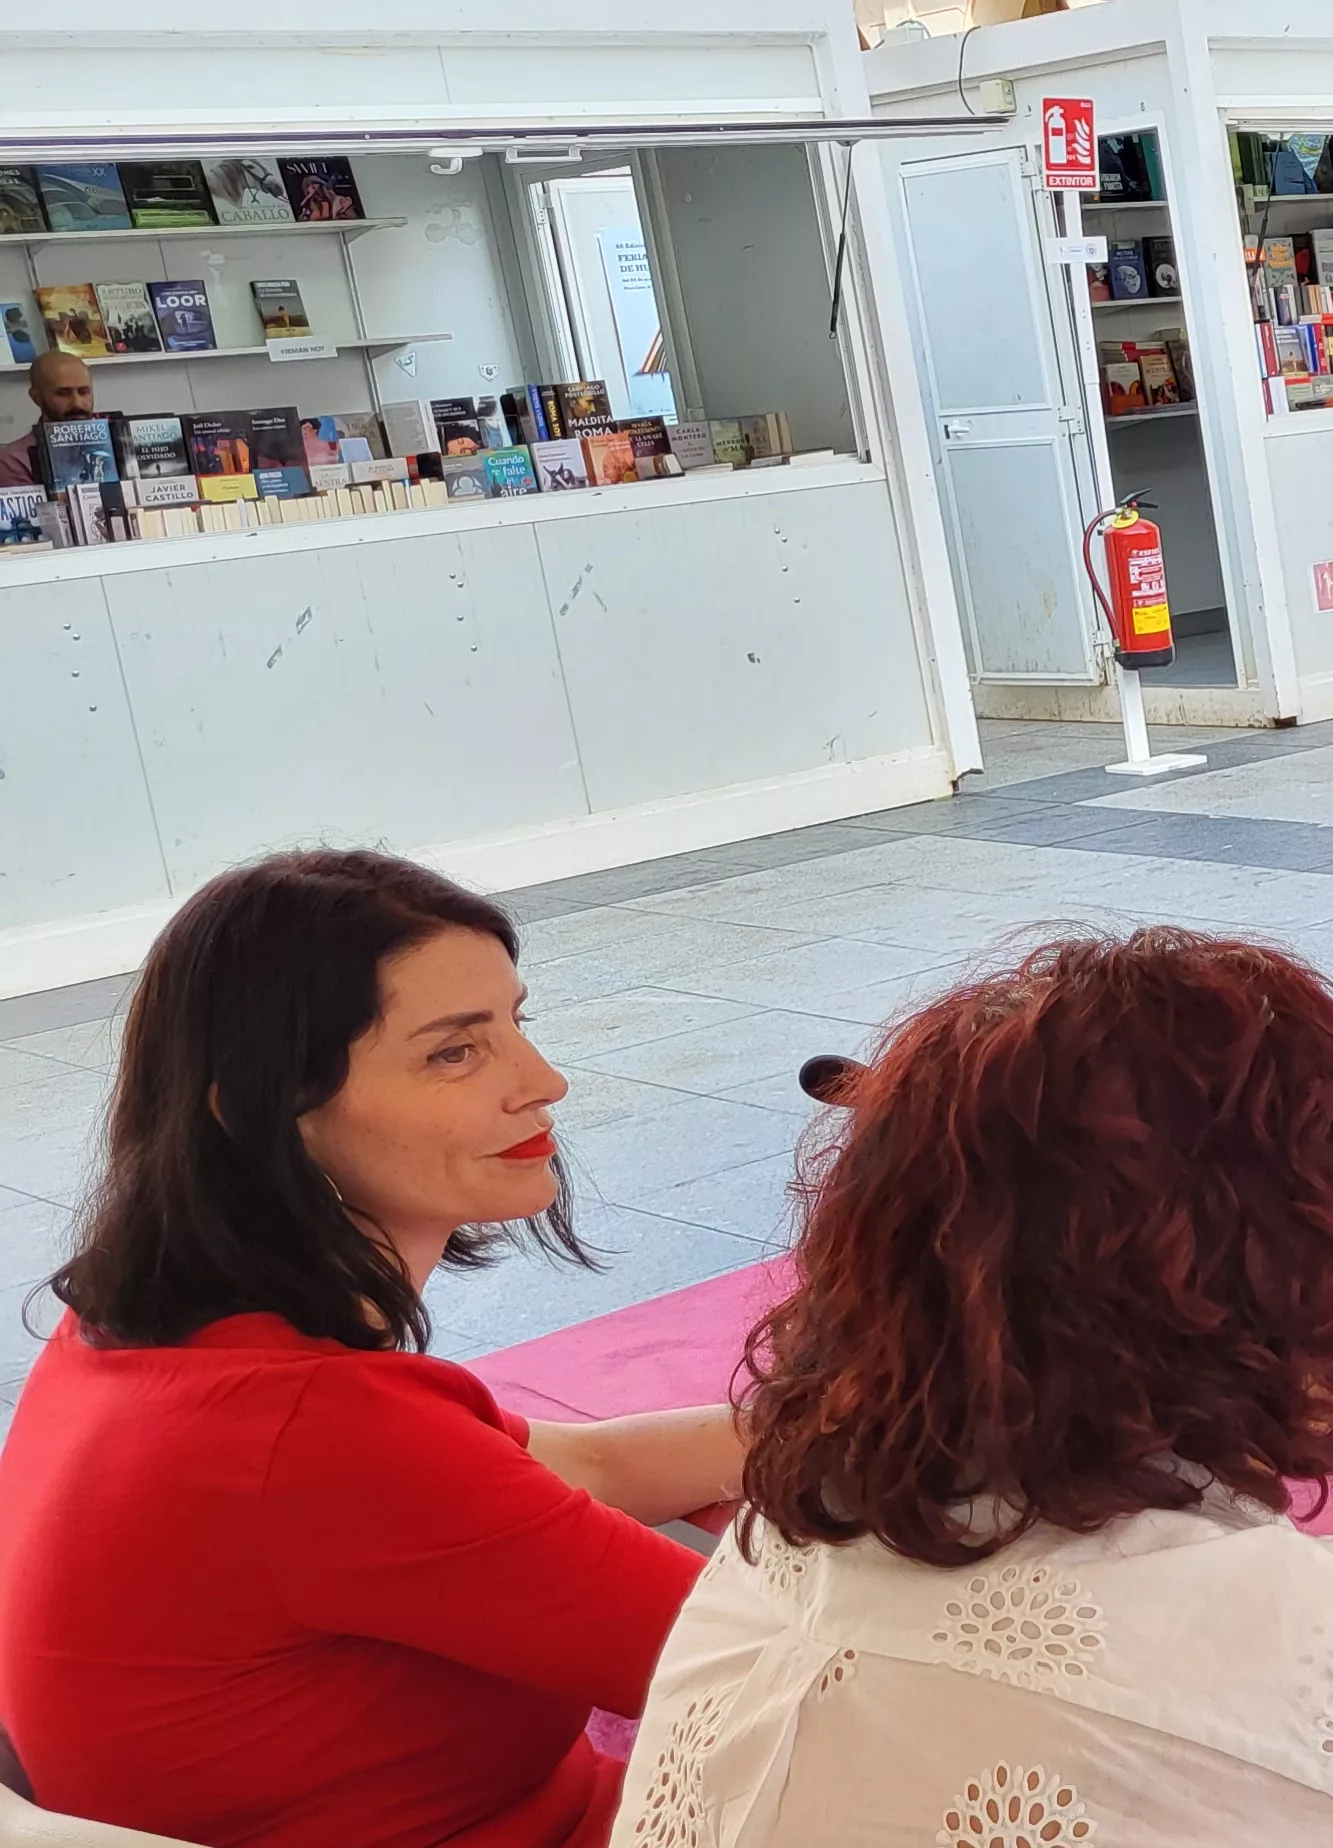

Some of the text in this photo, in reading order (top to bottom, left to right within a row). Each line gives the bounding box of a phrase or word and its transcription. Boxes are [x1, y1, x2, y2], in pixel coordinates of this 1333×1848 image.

[1048, 176, 1094, 187] EXTINTOR
[221, 207, 291, 223] CABALLO
[157, 294, 207, 308] LOOR
[568, 415, 616, 428] MALDITA
[53, 423, 107, 434] ROBERTO
[574, 427, 613, 440] ROMA
[50, 432, 108, 443] SANTIAGO
[671, 433, 707, 442] MONTERO
[488, 454, 524, 466] Cuando
[502, 465, 526, 477] falte
[151, 484, 186, 493] JAVIER
[145, 491, 194, 502] CASTILLO
